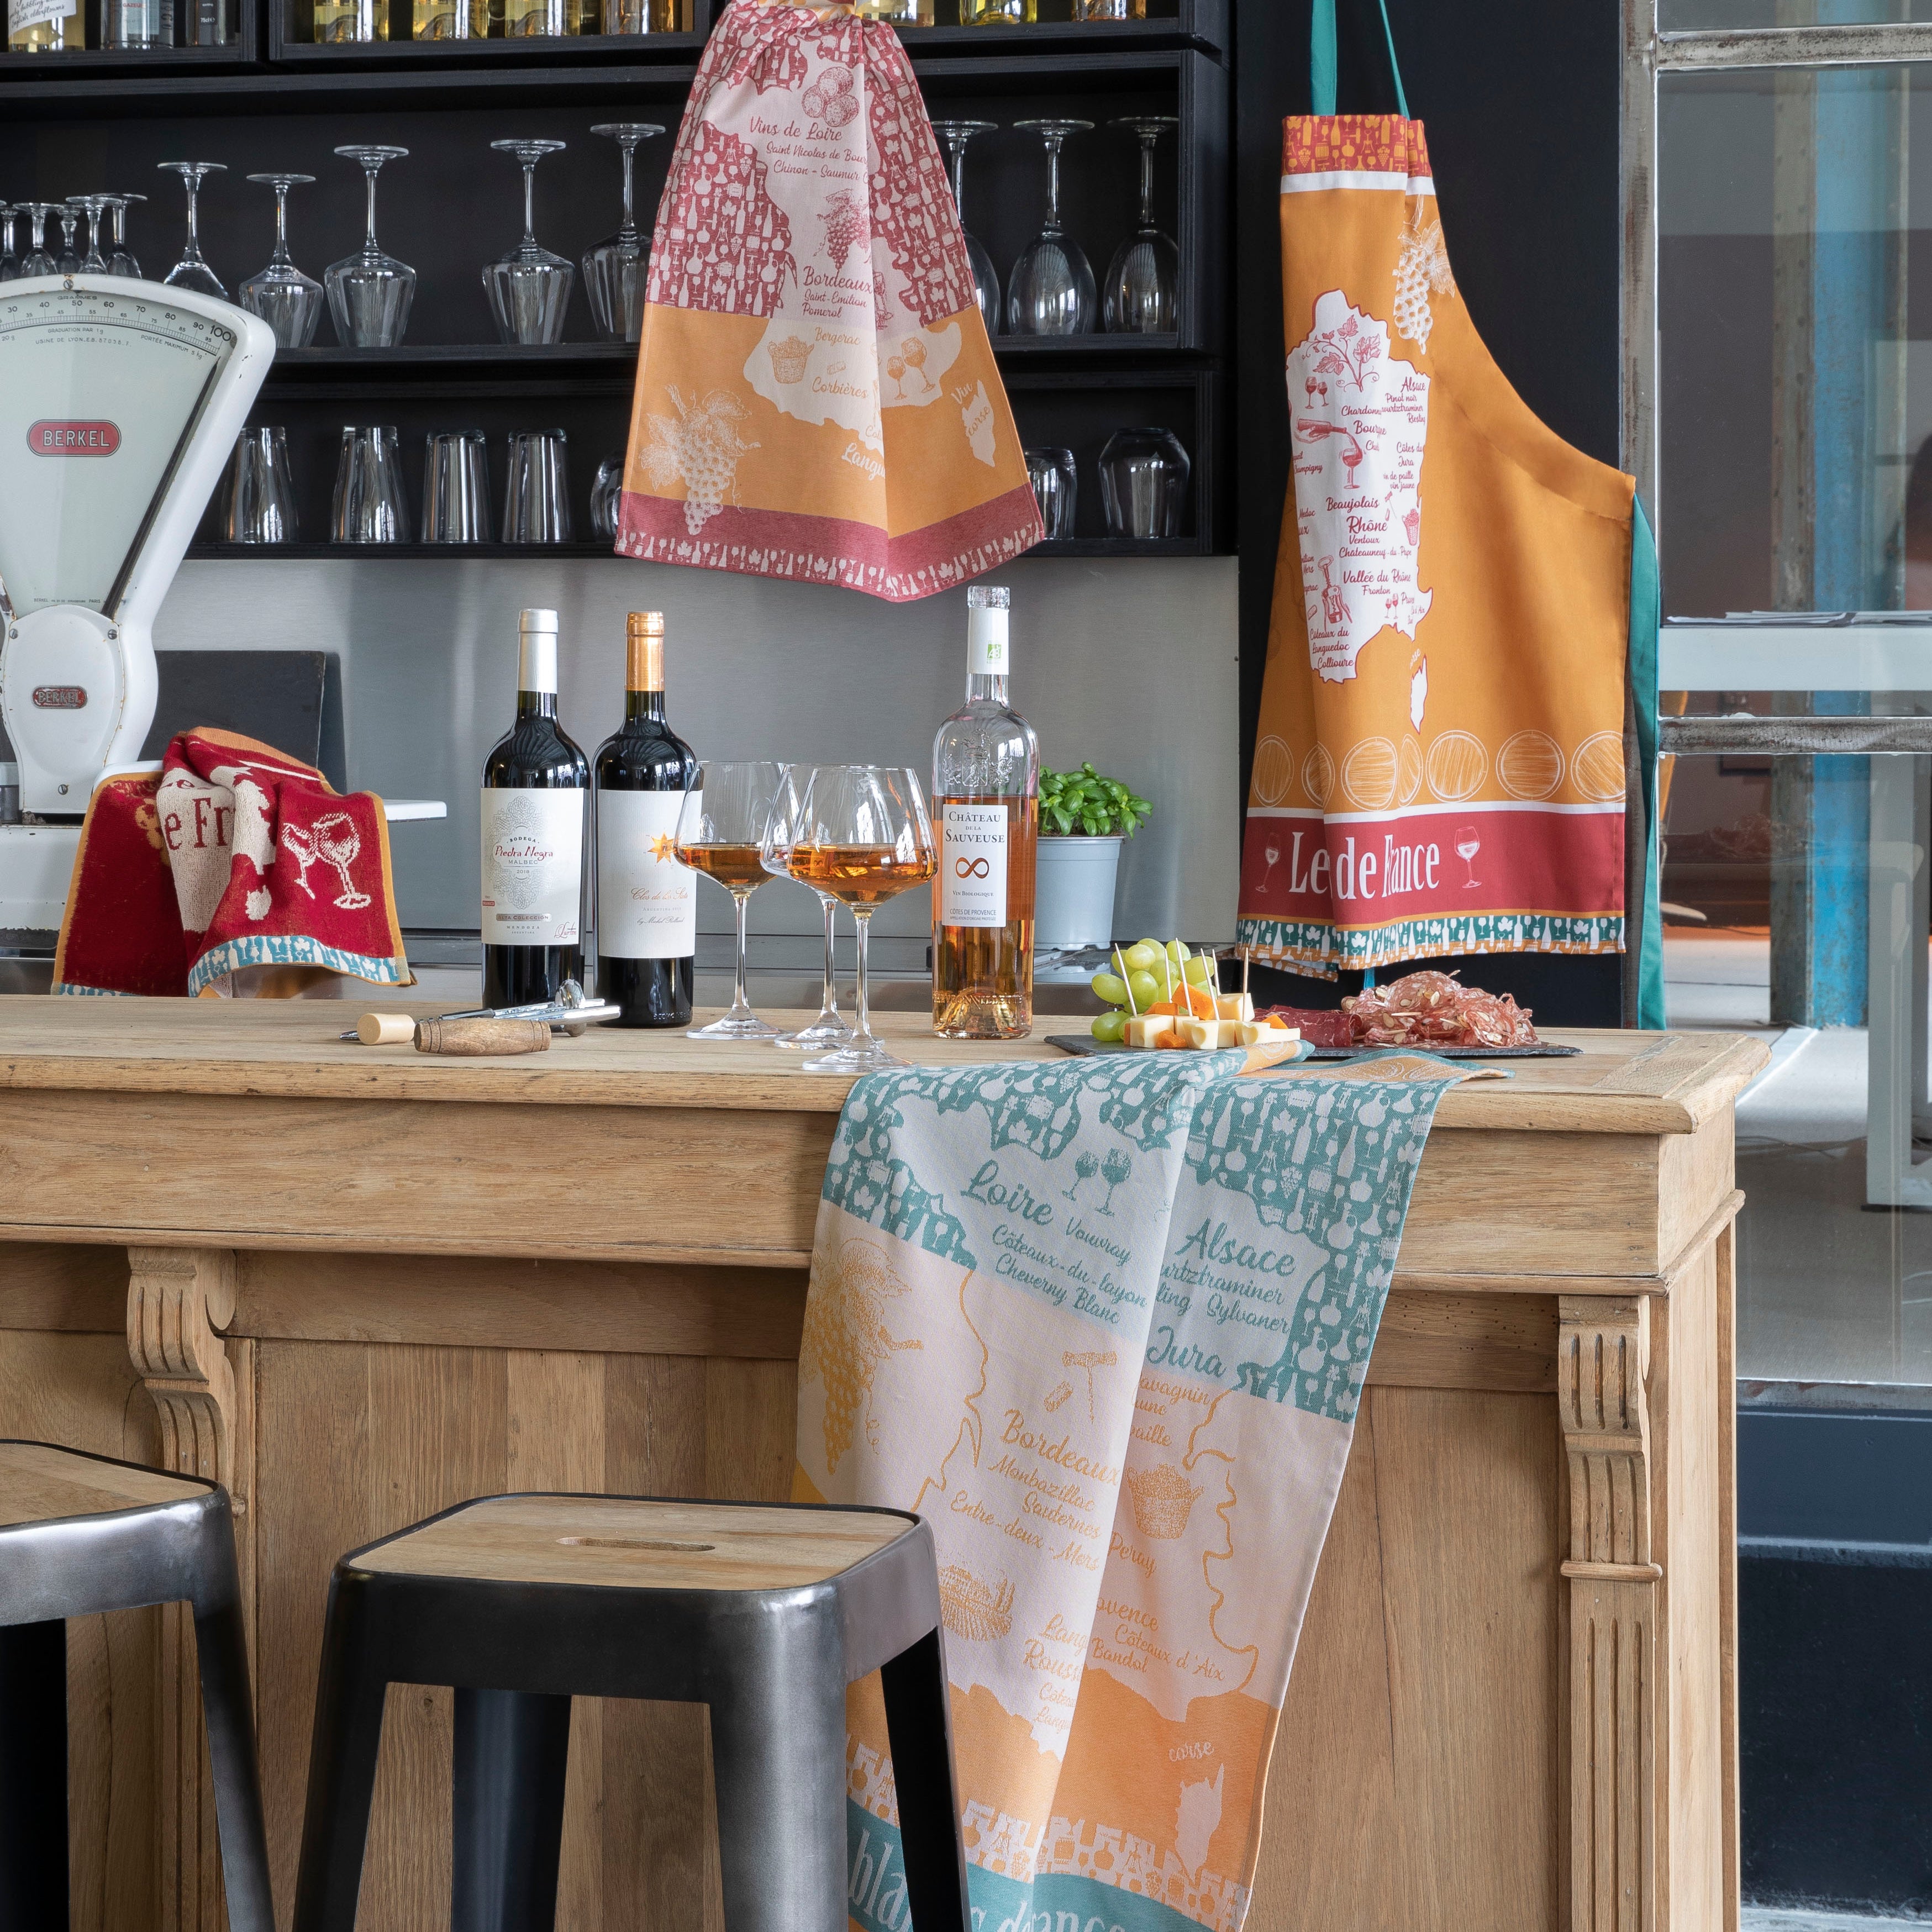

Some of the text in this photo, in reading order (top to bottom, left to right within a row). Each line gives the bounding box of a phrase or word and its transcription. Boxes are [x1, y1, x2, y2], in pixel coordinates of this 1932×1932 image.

[750, 116, 843, 141] Vins de Loire
[766, 141, 790, 154] Saint
[793, 145, 828, 159] Nicolas
[829, 149, 840, 159] de
[773, 160, 808, 175] Chinon
[820, 165, 860, 181] Saumur
[803, 265, 872, 294] Bordeaux
[802, 302, 843, 318] Pomerol
[136, 305, 146, 313] 70
[165, 312, 176, 320] 80
[193, 322, 204, 330] 90
[210, 324, 231, 341] 100
[141, 334, 162, 345] PORTÉE
[165, 341, 189, 353] MAXIMUM
[815, 327, 861, 346] Bergerac
[812, 376, 868, 399] Corbières
[950, 383, 972, 404] Vin
[1401, 377, 1426, 393] Alsace
[1385, 393, 1404, 403] Pinot
[968, 406, 991, 436] corse
[43, 430, 110, 446] BERKEL
[1398, 455, 1414, 467] Jura
[1390, 471, 1397, 480] de
[1398, 470, 1414, 483] paille
[1400, 482, 1415, 492] jaune
[1326, 496, 1380, 513] Beaujolais
[1346, 515, 1388, 534] Rhône
[1349, 535, 1381, 545] Ventoux
[1343, 568, 1411, 584] Vallée du Rhône
[1362, 585, 1391, 596] Fronton
[1338, 627, 1350, 638] du
[1312, 641, 1350, 656] Languedoc
[1318, 657, 1354, 669] Collioure
[38, 692, 81, 704] BERKEL
[495, 845, 553, 861] Piedra Negra
[1289, 831, 1330, 894] Le
[1336, 836, 1377, 899] de
[631, 887, 650, 900] Clos
[651, 891, 662, 900] de
[960, 1159, 1054, 1226] Loire
[1066, 1217, 1133, 1267] Vouvray
[1174, 1217, 1297, 1277] Alsace
[996, 1252, 1121, 1324] Cheverny Blanc
[1155, 1281, 1291, 1334] ling Sylvaner
[1146, 1325, 1228, 1378] Jura
[1138, 1377, 1210, 1405] avagnin
[1000, 1408, 1121, 1486] Bordeaux
[987, 1452, 1096, 1512] Monbazillac
[1022, 1491, 1101, 1540] Sauternes
[1096, 1597, 1159, 1631] ovence
[1091, 1636, 1150, 1673] Bandol
[1168, 1741, 1215, 1762] corse
